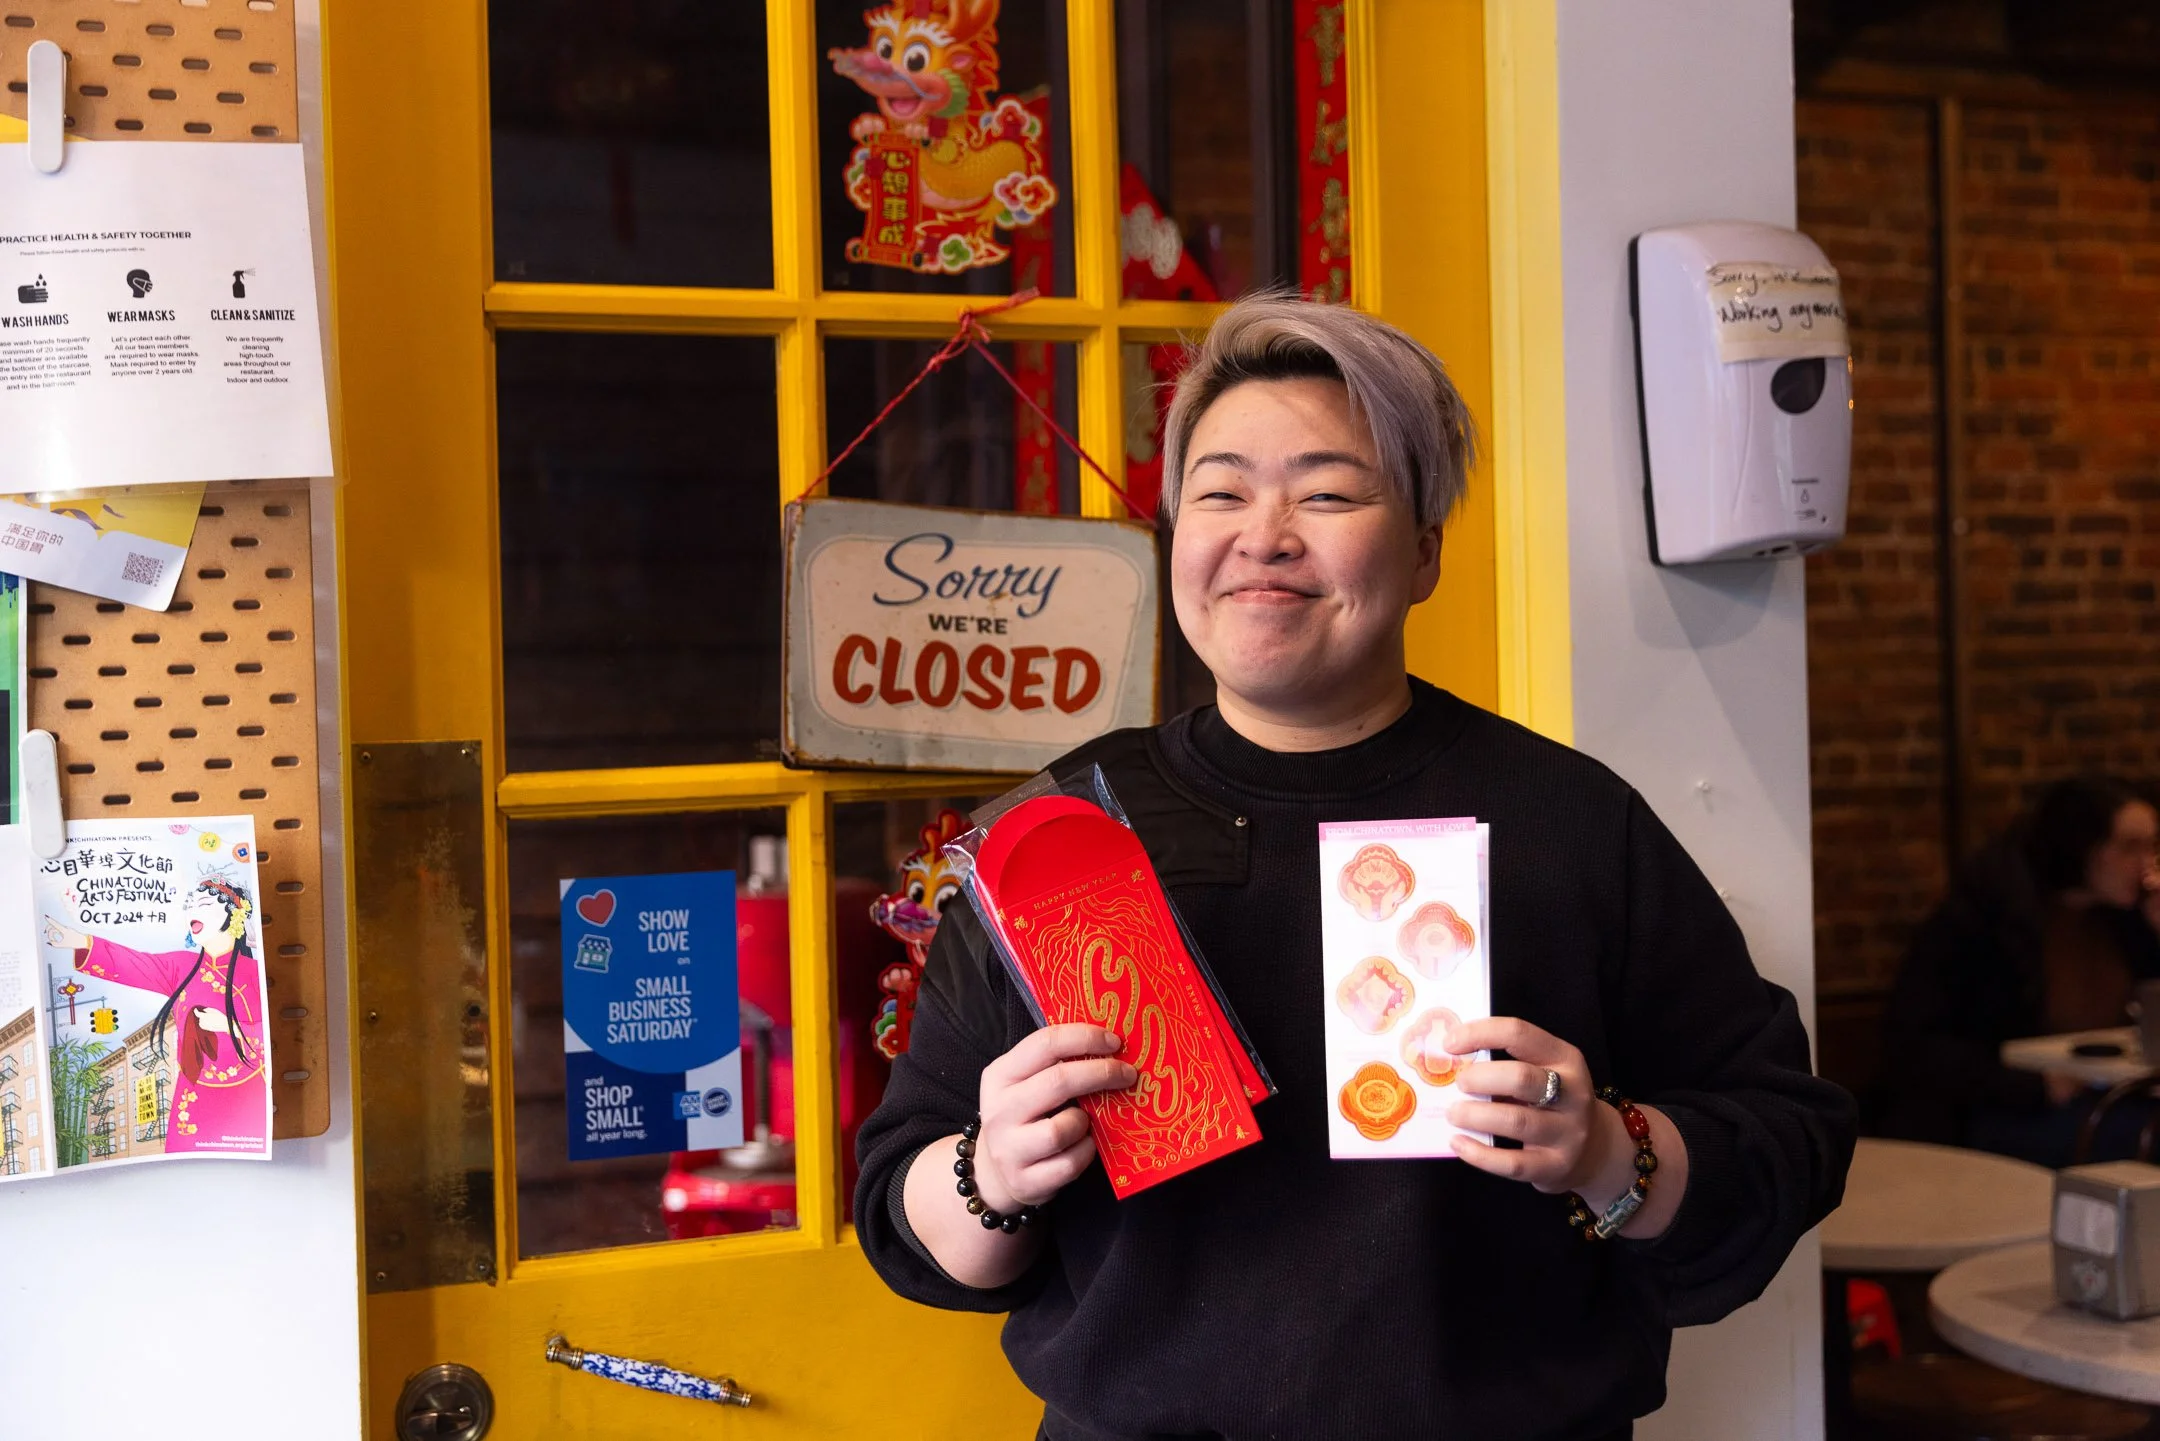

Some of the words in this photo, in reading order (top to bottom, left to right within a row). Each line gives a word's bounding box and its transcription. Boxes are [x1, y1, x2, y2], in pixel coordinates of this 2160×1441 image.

[0, 235, 48, 244] PRACTICE
[50, 232, 89, 241] HEALTH
[92, 232, 98, 240] &
[101, 231, 136, 240] SAFETY
[140, 231, 192, 240] TOGETHER
[1, 316, 33, 328] WASH
[34, 313, 69, 327] HANDS
[107, 310, 137, 323] WEAR
[138, 309, 176, 322] MASKS
[210, 309, 243, 321] CLEAN
[243, 309, 251, 321] &
[252, 309, 296, 321] SANITIZE
[14, 339, 32, 347] wash
[33, 337, 55, 346] hands
[56, 335, 91, 345] frequently
[111, 335, 128, 343] Let's
[129, 334, 153, 343] protect
[154, 333, 172, 342] each
[225, 335, 238, 343] We
[239, 335, 251, 343] are
[251, 334, 285, 344] frequently
[44, 346, 53, 354] 20
[242, 344, 270, 352] cleaning
[14, 355, 42, 364] sanitizer
[58, 352, 88, 362] available
[119, 351, 148, 360] required
[12, 364, 36, 373] bottom
[46, 362, 57, 370] the
[110, 361, 129, 369] Mask
[130, 359, 159, 368] required
[160, 359, 167, 367] to
[168, 359, 186, 367] enter
[187, 358, 197, 368] by
[223, 360, 243, 368] areas
[243, 359, 279, 369] throughout
[280, 360, 292, 368] our
[10, 373, 28, 382] entry
[29, 372, 43, 380] into
[44, 371, 55, 379] the
[56, 369, 92, 378] restaurant
[111, 368, 137, 378] anyone
[138, 368, 153, 376] over
[161, 367, 181, 377] years
[6, 383, 20, 391] and
[29, 381, 41, 389] the
[226, 376, 249, 384] Indoor
[249, 376, 263, 384] and
[873, 533, 1064, 620] Sorry
[929, 612, 1008, 635] WE'RE
[832, 633, 1104, 715] CLOSED
[1416, 823, 1441, 834] WITH
[1444, 822, 1469, 832] LOVE
[119, 834, 152, 842] PRESENTS
[76, 876, 166, 893] CHINATOWN
[1033, 892, 1065, 910] HAPPY
[1068, 883, 1089, 897] NEW
[1092, 872, 1117, 887] YEAR
[79, 890, 114, 907] ARTS
[115, 888, 171, 905] FESTIVAL
[80, 909, 110, 923] OCT
[113, 911, 143, 924] 2024
[147, 910, 167, 923] 十月
[638, 909, 690, 933] SHOW
[647, 930, 690, 953] LOVE
[676, 956, 691, 966] on
[635, 975, 692, 999] SMALL
[1185, 983, 1202, 1017] SNAKE
[608, 997, 692, 1023] BUSINESS
[584, 1075, 605, 1087] and
[585, 1085, 634, 1109] SHOP
[586, 1131, 599, 1142] all
[599, 1130, 621, 1144] year
[1235, 1124, 1250, 1140] 春
